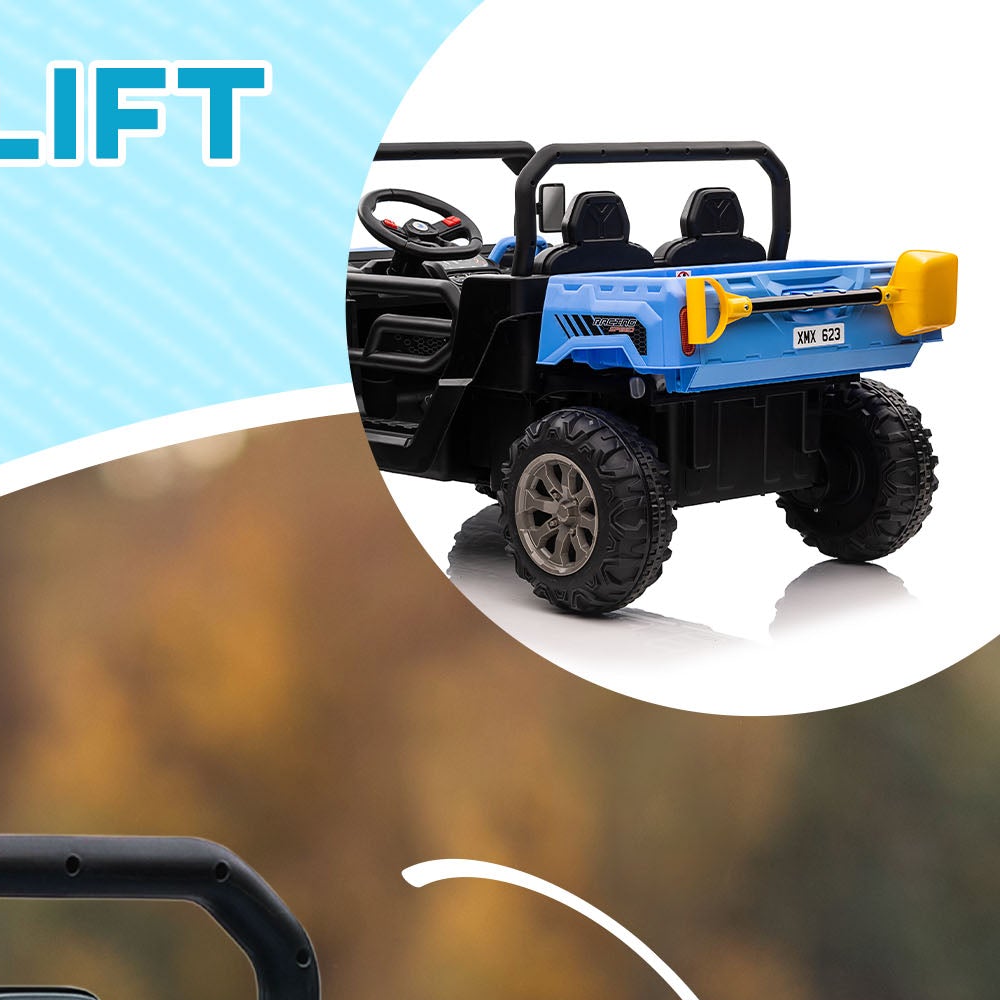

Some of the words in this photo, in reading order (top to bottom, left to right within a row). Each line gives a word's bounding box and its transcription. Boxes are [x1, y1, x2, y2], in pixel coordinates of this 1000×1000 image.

[592, 317, 638, 328] RACING
[797, 329, 817, 345] XMX
[821, 327, 841, 342] 623
